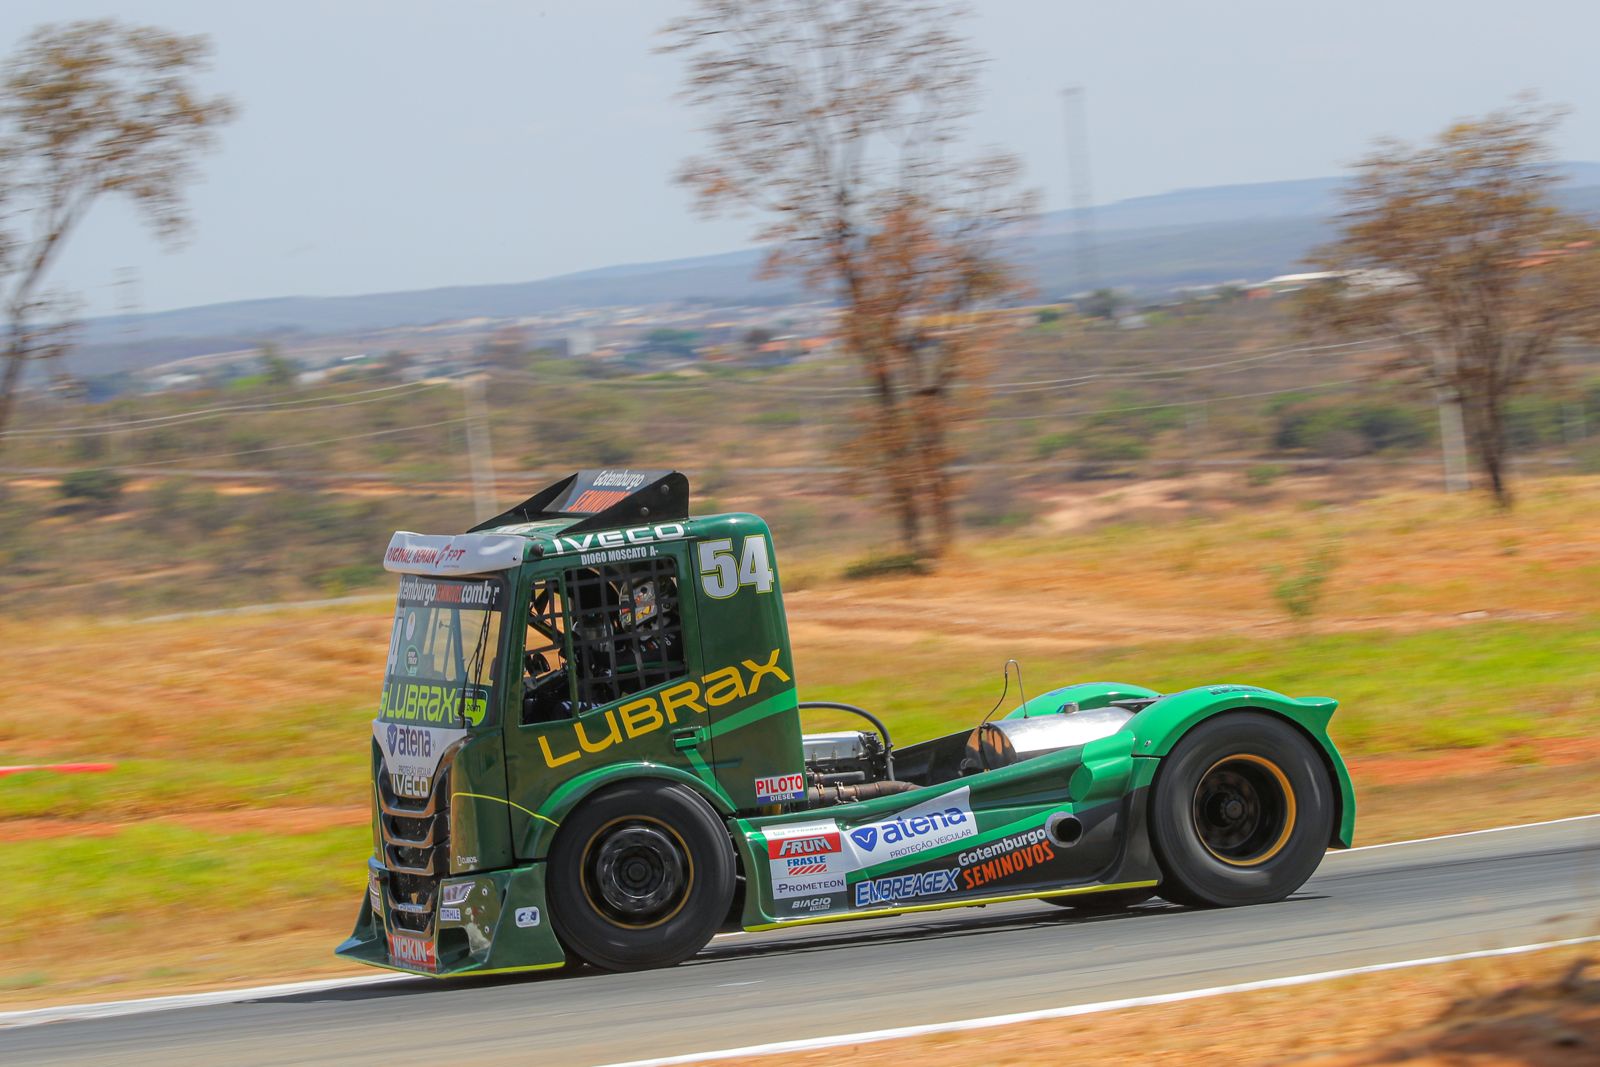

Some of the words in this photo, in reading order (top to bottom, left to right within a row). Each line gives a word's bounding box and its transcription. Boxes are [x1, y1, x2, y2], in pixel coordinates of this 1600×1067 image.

[592, 469, 645, 490] Gotemburgo
[552, 523, 684, 555] IVECO
[446, 549, 466, 561] FPT
[580, 551, 607, 566] DIOGO
[607, 546, 647, 562] MOSCATO
[697, 534, 774, 600] 54
[398, 726, 431, 757] atena
[393, 774, 429, 799] IVECO
[756, 775, 803, 795] PILOTO
[770, 793, 795, 802] DIESEL
[882, 807, 967, 844] atena
[779, 836, 832, 856] FRUM
[890, 839, 933, 858] PROTEÇÃO
[934, 828, 972, 845] VEICULAR
[958, 828, 1047, 866] Gotemburgo
[787, 855, 826, 867] FRASLE
[963, 840, 1055, 889] SEMINOVOS
[776, 880, 844, 893] PROMETEON
[855, 867, 960, 907] EMBREAGEX
[792, 897, 831, 909] BIAGIO
[441, 909, 460, 920] MAHLE
[393, 937, 427, 961] WOKIN
